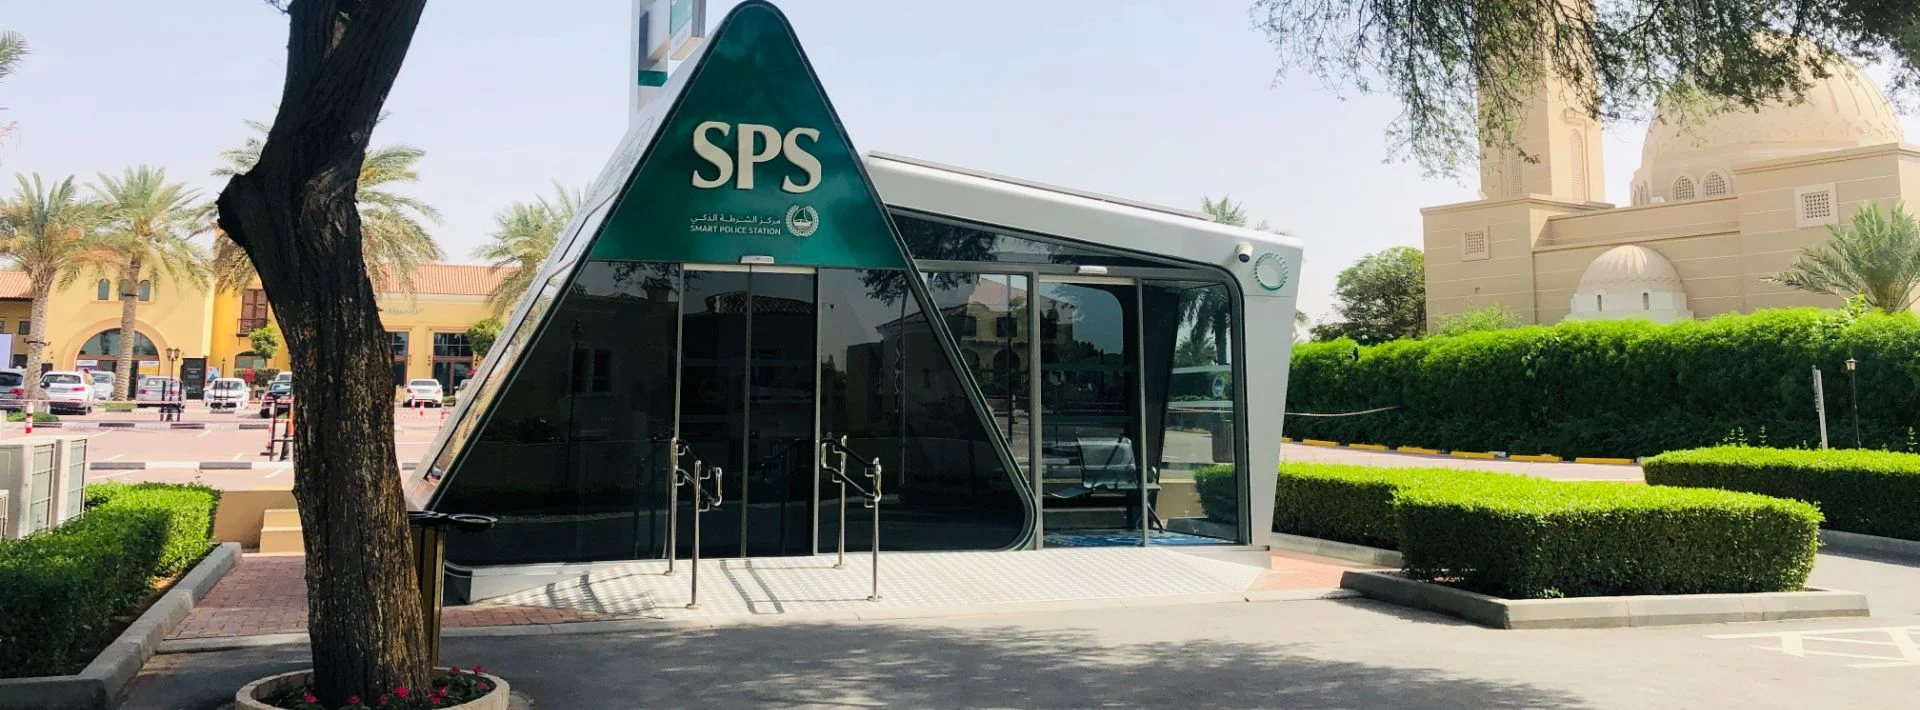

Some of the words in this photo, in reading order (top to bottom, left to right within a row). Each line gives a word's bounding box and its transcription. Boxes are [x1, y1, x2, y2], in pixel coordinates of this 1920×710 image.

[692, 120, 822, 194] SPS
[690, 213, 718, 225] الذكي
[720, 213, 758, 224] الشرطة
[760, 216, 781, 226] مركز
[690, 224, 718, 233] SMART
[720, 225, 747, 234] POLICE
[748, 226, 781, 235] STATION
